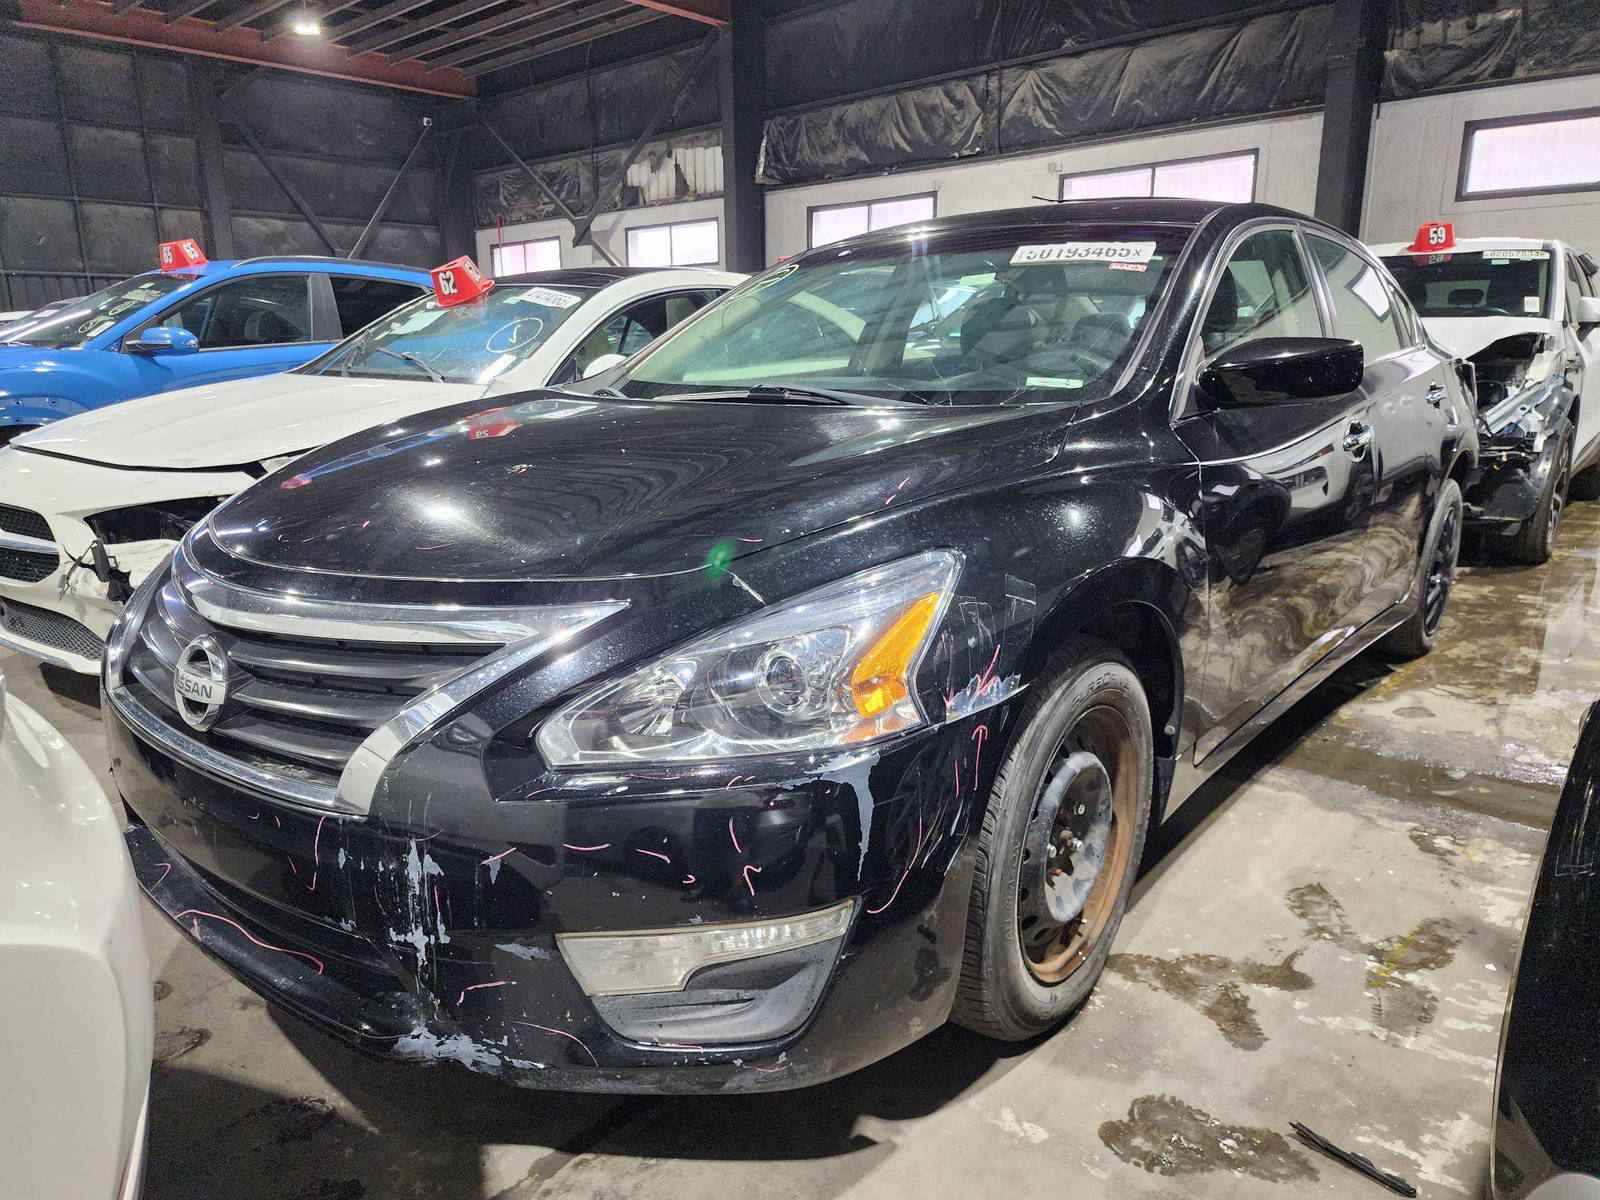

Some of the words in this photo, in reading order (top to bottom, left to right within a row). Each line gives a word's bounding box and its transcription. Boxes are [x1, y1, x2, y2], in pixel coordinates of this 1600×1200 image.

[1429, 226, 1446, 245] 59
[162, 246, 173, 264] 65
[182, 241, 199, 258] 65
[438, 271, 458, 296] 62
